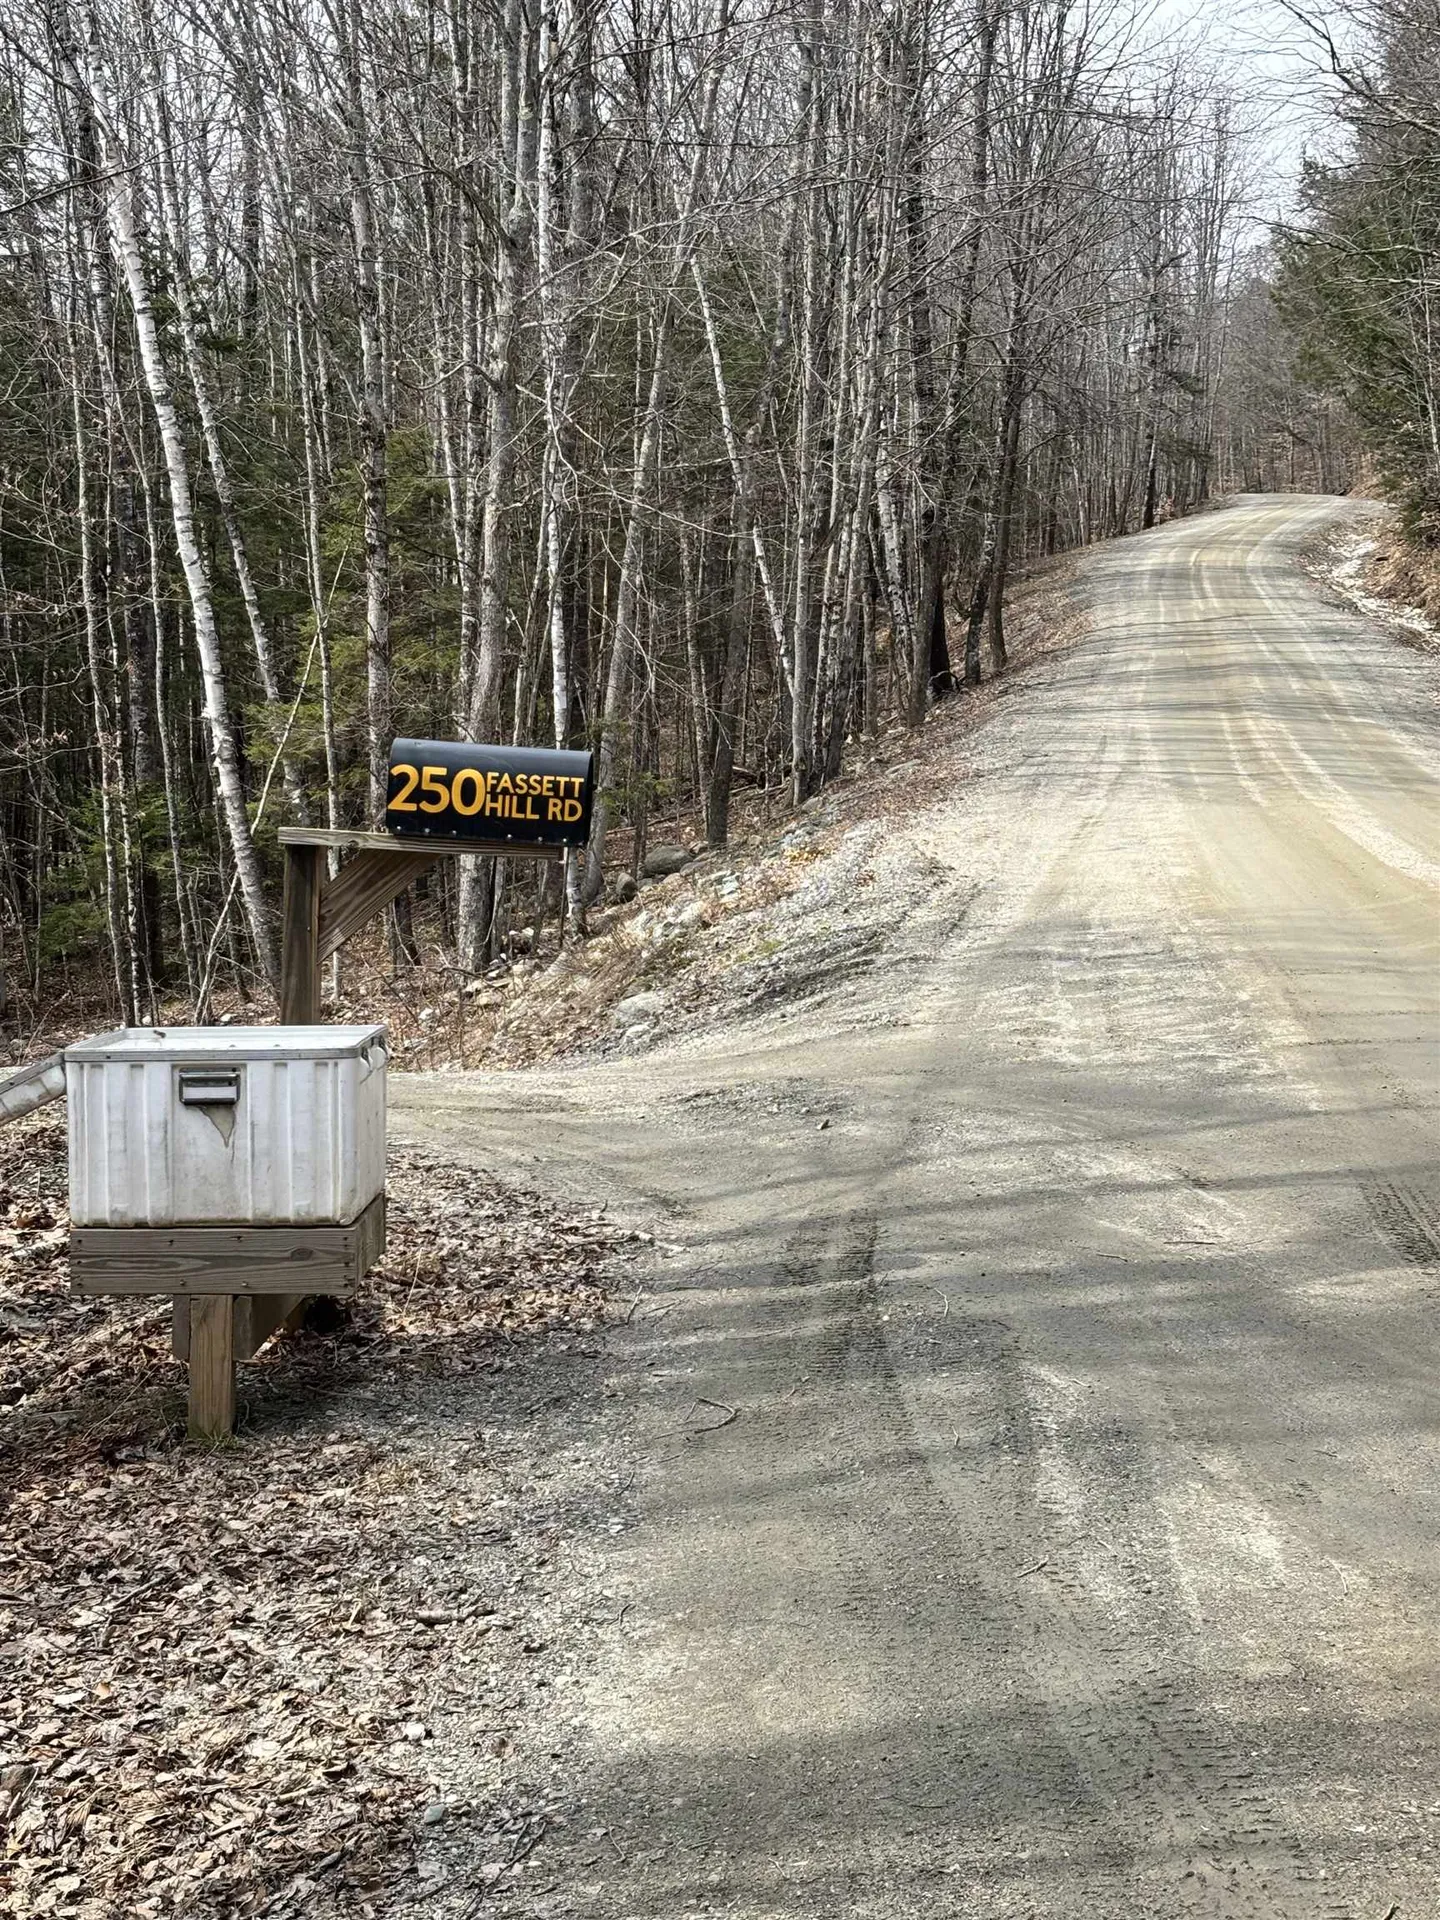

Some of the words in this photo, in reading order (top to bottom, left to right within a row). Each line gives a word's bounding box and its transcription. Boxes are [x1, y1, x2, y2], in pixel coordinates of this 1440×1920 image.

[388, 764, 485, 816] 250
[486, 772, 584, 797] FASSETT
[485, 794, 539, 819] HILL
[547, 797, 583, 822] RD
